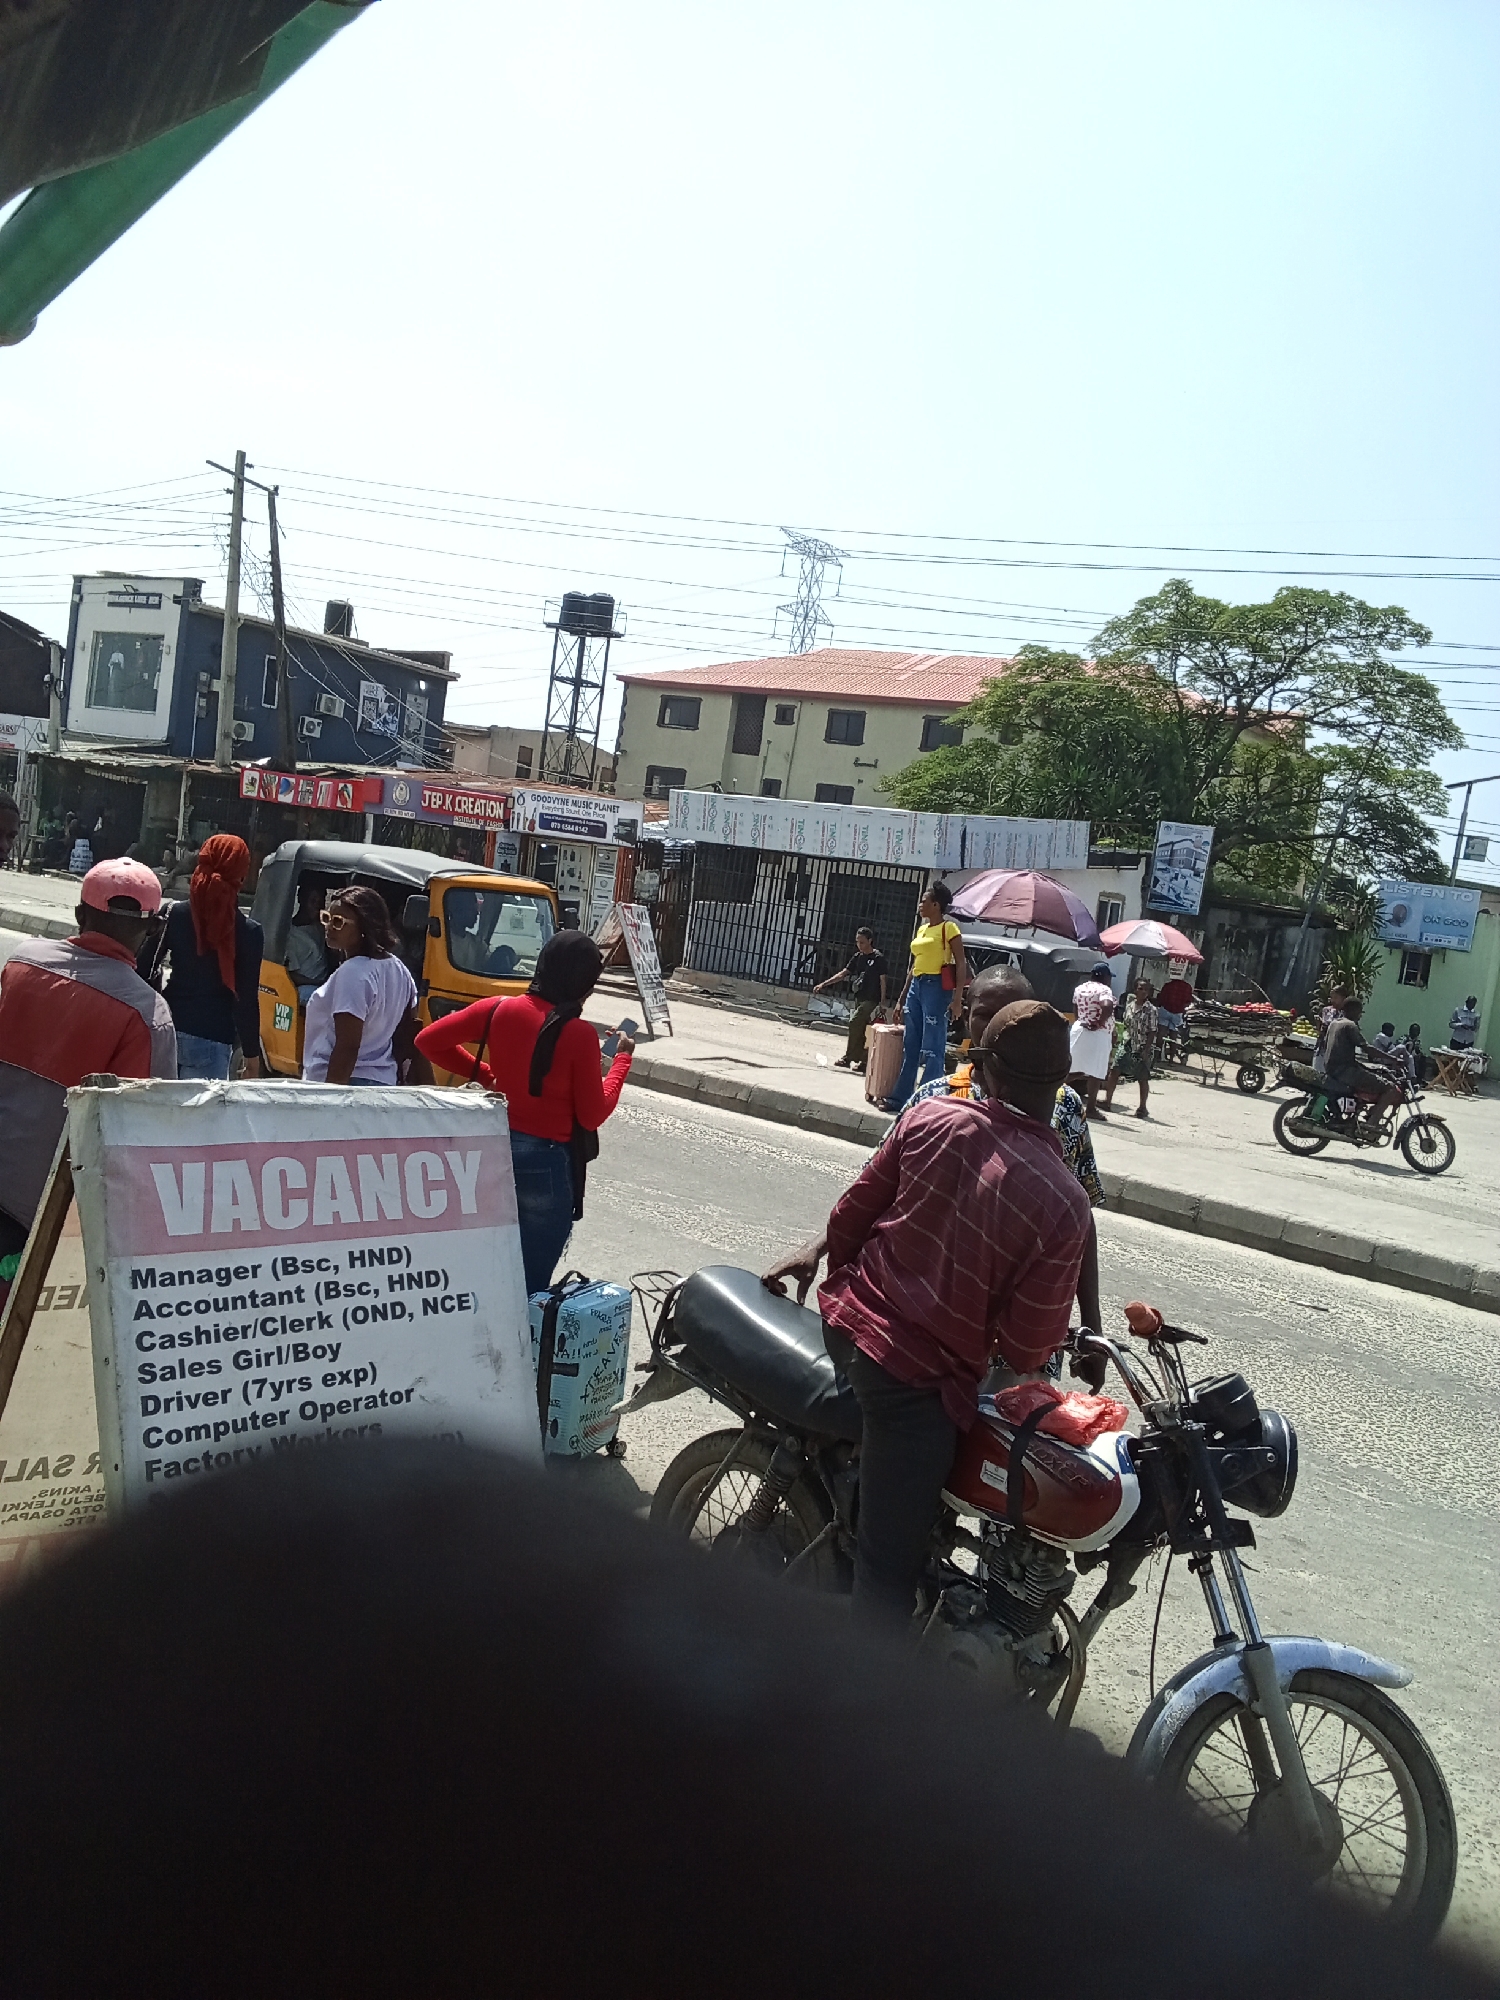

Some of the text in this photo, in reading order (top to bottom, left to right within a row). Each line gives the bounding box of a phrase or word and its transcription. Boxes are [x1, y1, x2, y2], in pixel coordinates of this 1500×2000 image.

[571, 799, 593, 810] MUSIC
[594, 801, 620, 814] PLANET
[1383, 883, 1473, 902] LISTEN TO
[276, 1002, 290, 1017] VIP
[150, 1150, 482, 1237] VACANCY
[131, 1245, 412, 1292] Manager (Bsc, HND)
[133, 1268, 450, 1321] Accountant (Bsc, HND)
[134, 1292, 480, 1353] Cashier/Clerk (OND, NCE)
[137, 1341, 342, 1386] Sales Girl/Boy
[140, 1361, 377, 1418] Driver (7yrs exp)
[142, 1387, 415, 1450] Computer Operator
[145, 1444, 263, 1483] Factory
